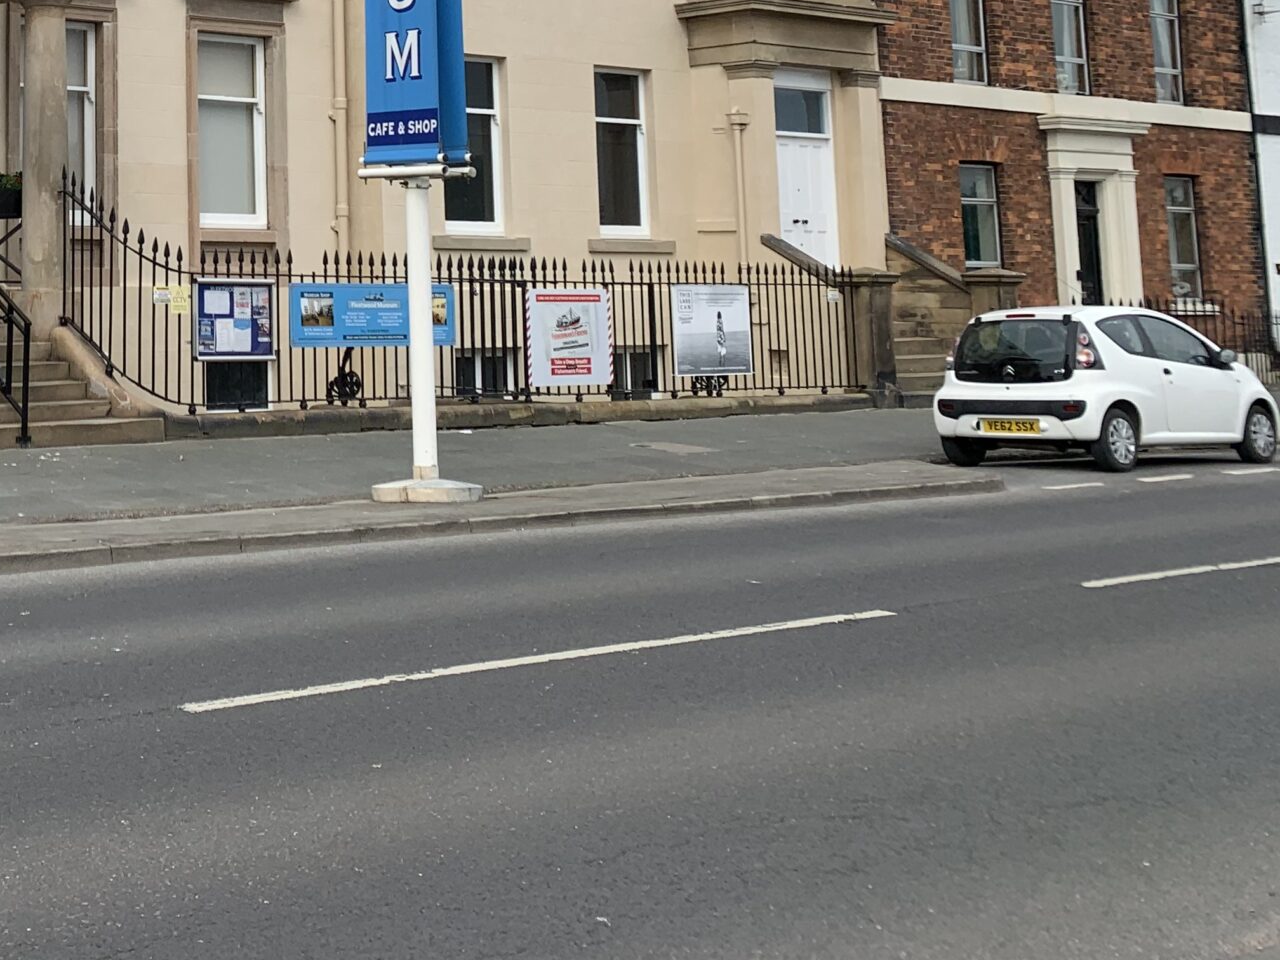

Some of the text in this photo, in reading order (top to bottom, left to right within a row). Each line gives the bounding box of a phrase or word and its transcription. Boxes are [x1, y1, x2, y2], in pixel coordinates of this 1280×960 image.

[368, 119, 438, 136] CAFE & SHOP
[987, 420, 1035, 432] YE62 SSX
